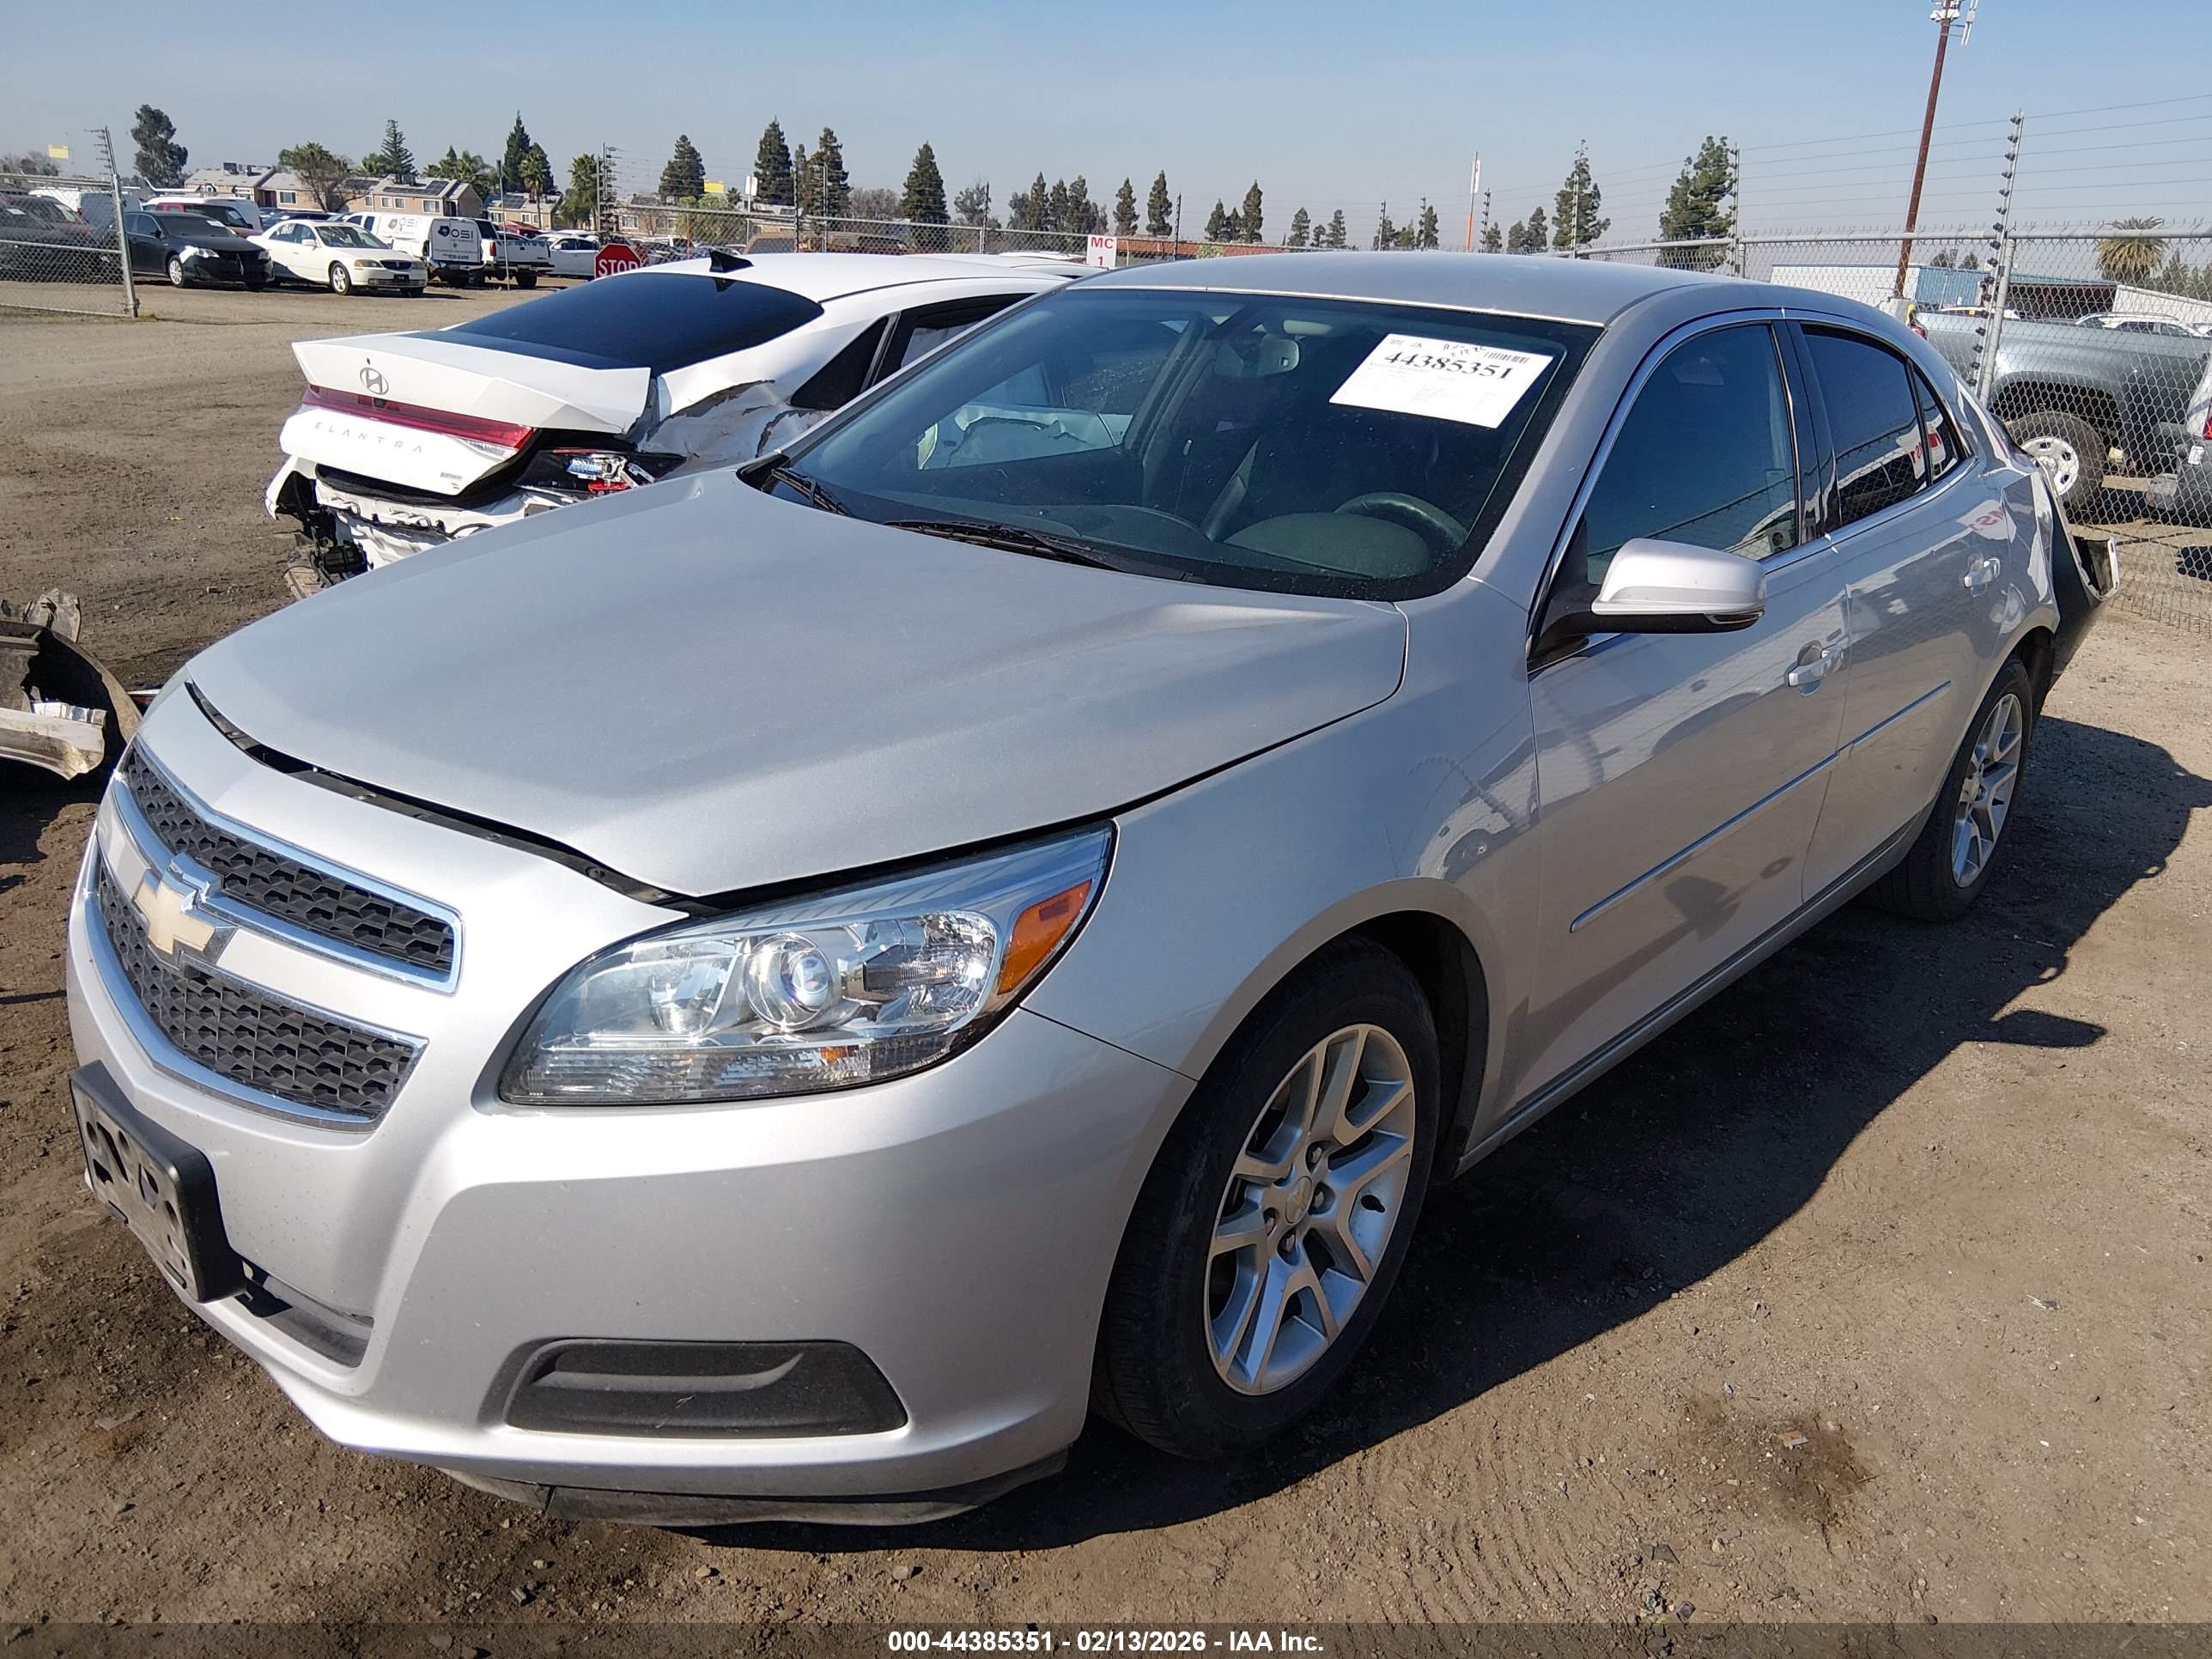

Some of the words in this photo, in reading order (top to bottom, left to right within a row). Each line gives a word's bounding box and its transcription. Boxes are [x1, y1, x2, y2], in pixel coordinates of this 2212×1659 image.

[451, 228, 474, 240] OSI
[1091, 237, 1114, 249] MC
[598, 258, 638, 276] STOP
[1097, 256, 1103, 266] 1
[1384, 351, 1513, 380] 44385351
[314, 422, 422, 453] ELANTRA
